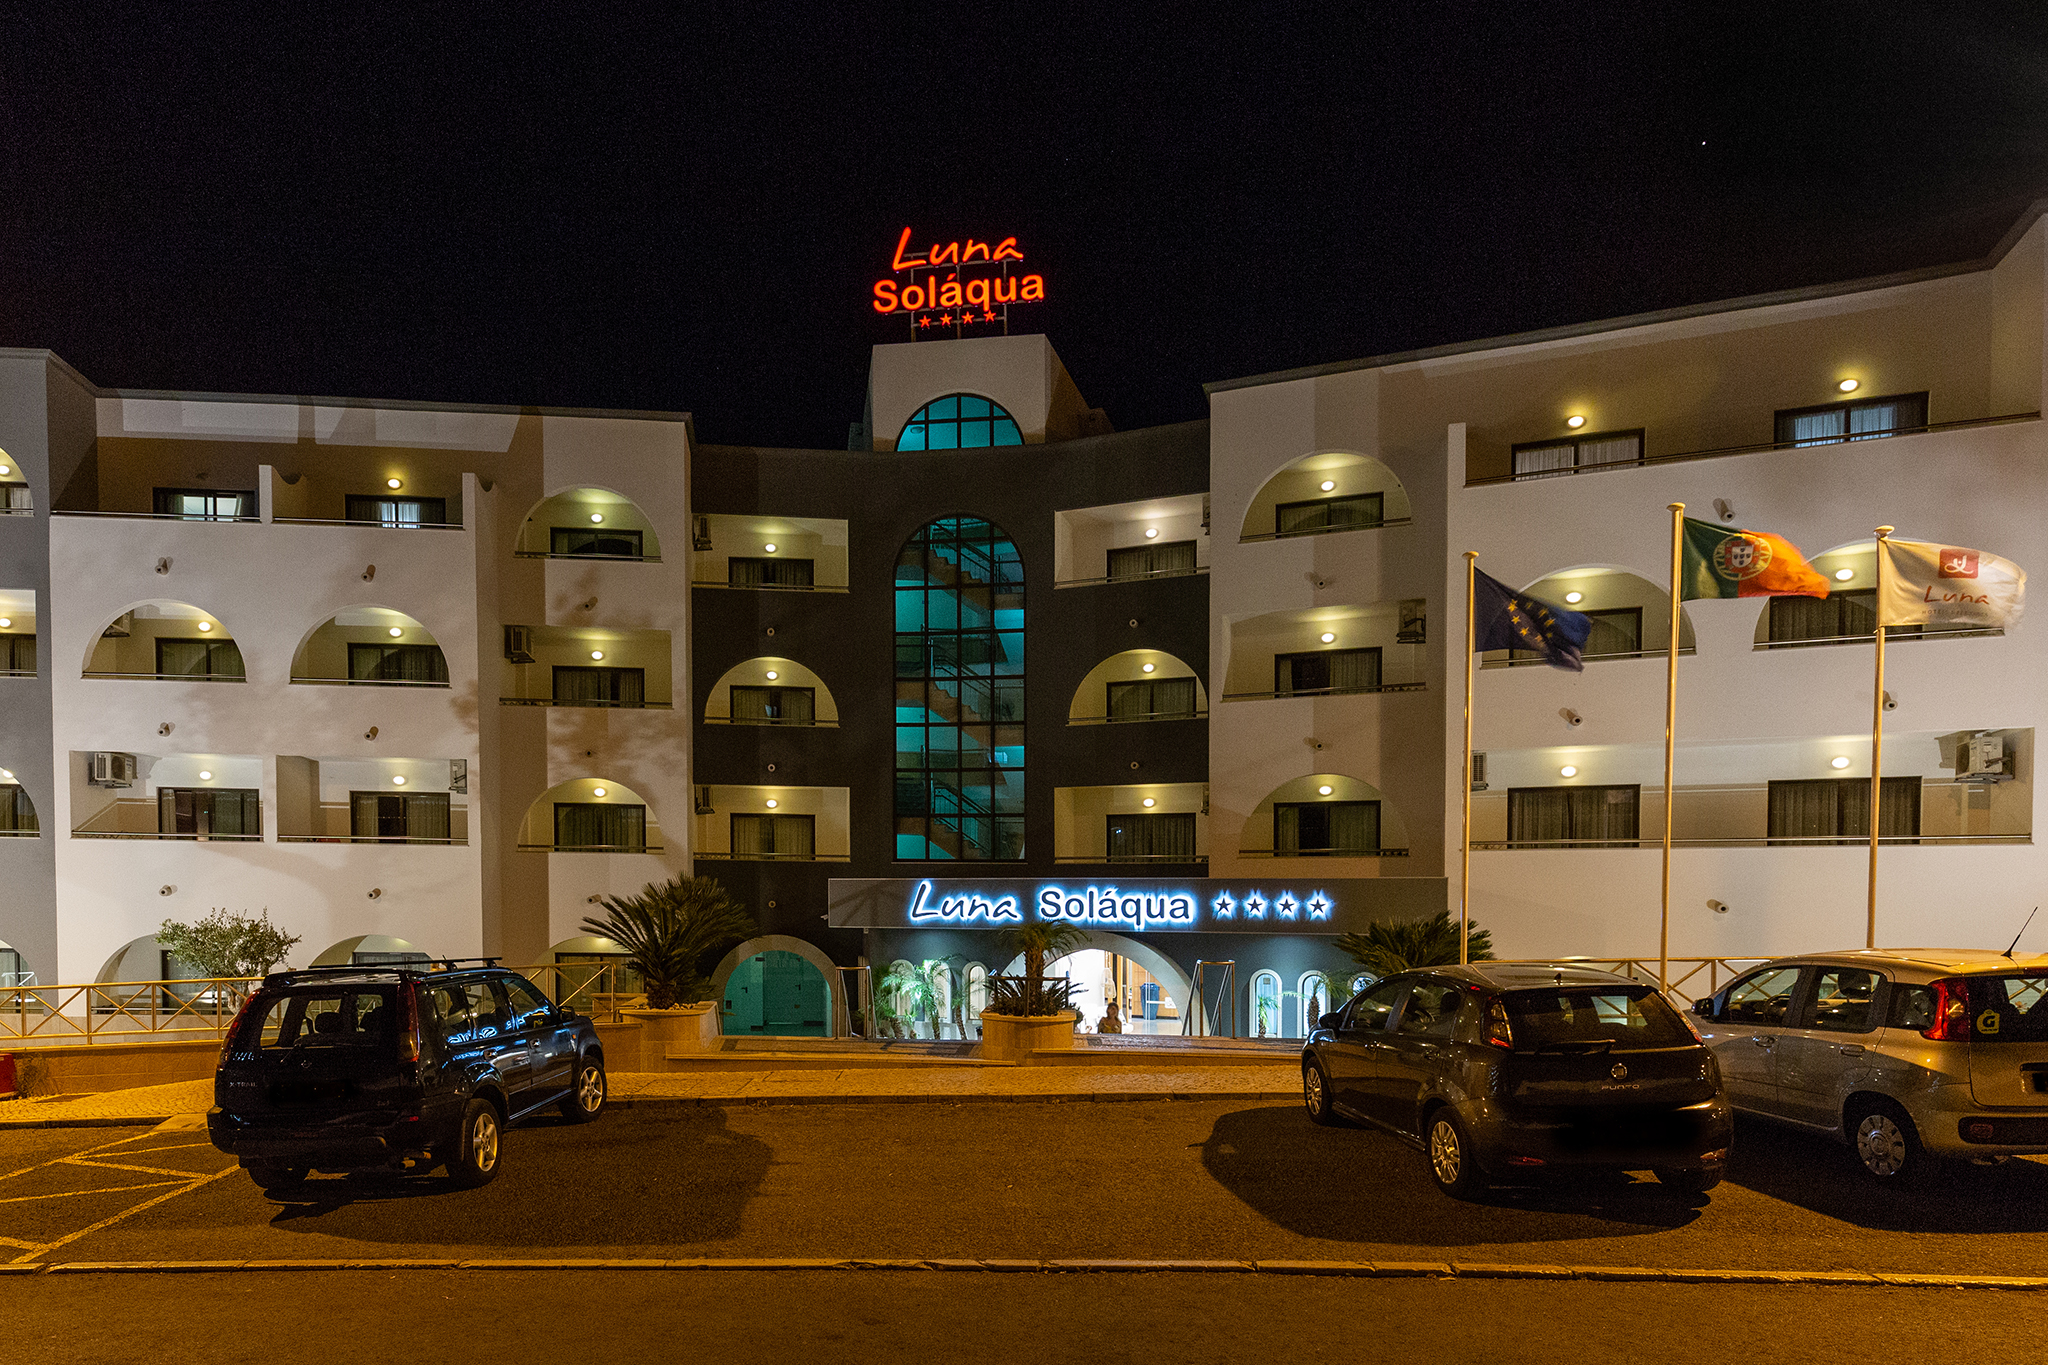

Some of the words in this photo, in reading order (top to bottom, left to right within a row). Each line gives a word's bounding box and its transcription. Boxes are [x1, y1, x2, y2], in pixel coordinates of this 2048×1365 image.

[892, 226, 1024, 271] Luna
[873, 273, 1045, 313] Soláqua
[1923, 585, 1990, 605] Luna
[910, 881, 1020, 920] Luna
[1039, 889, 1191, 927] Soláqua
